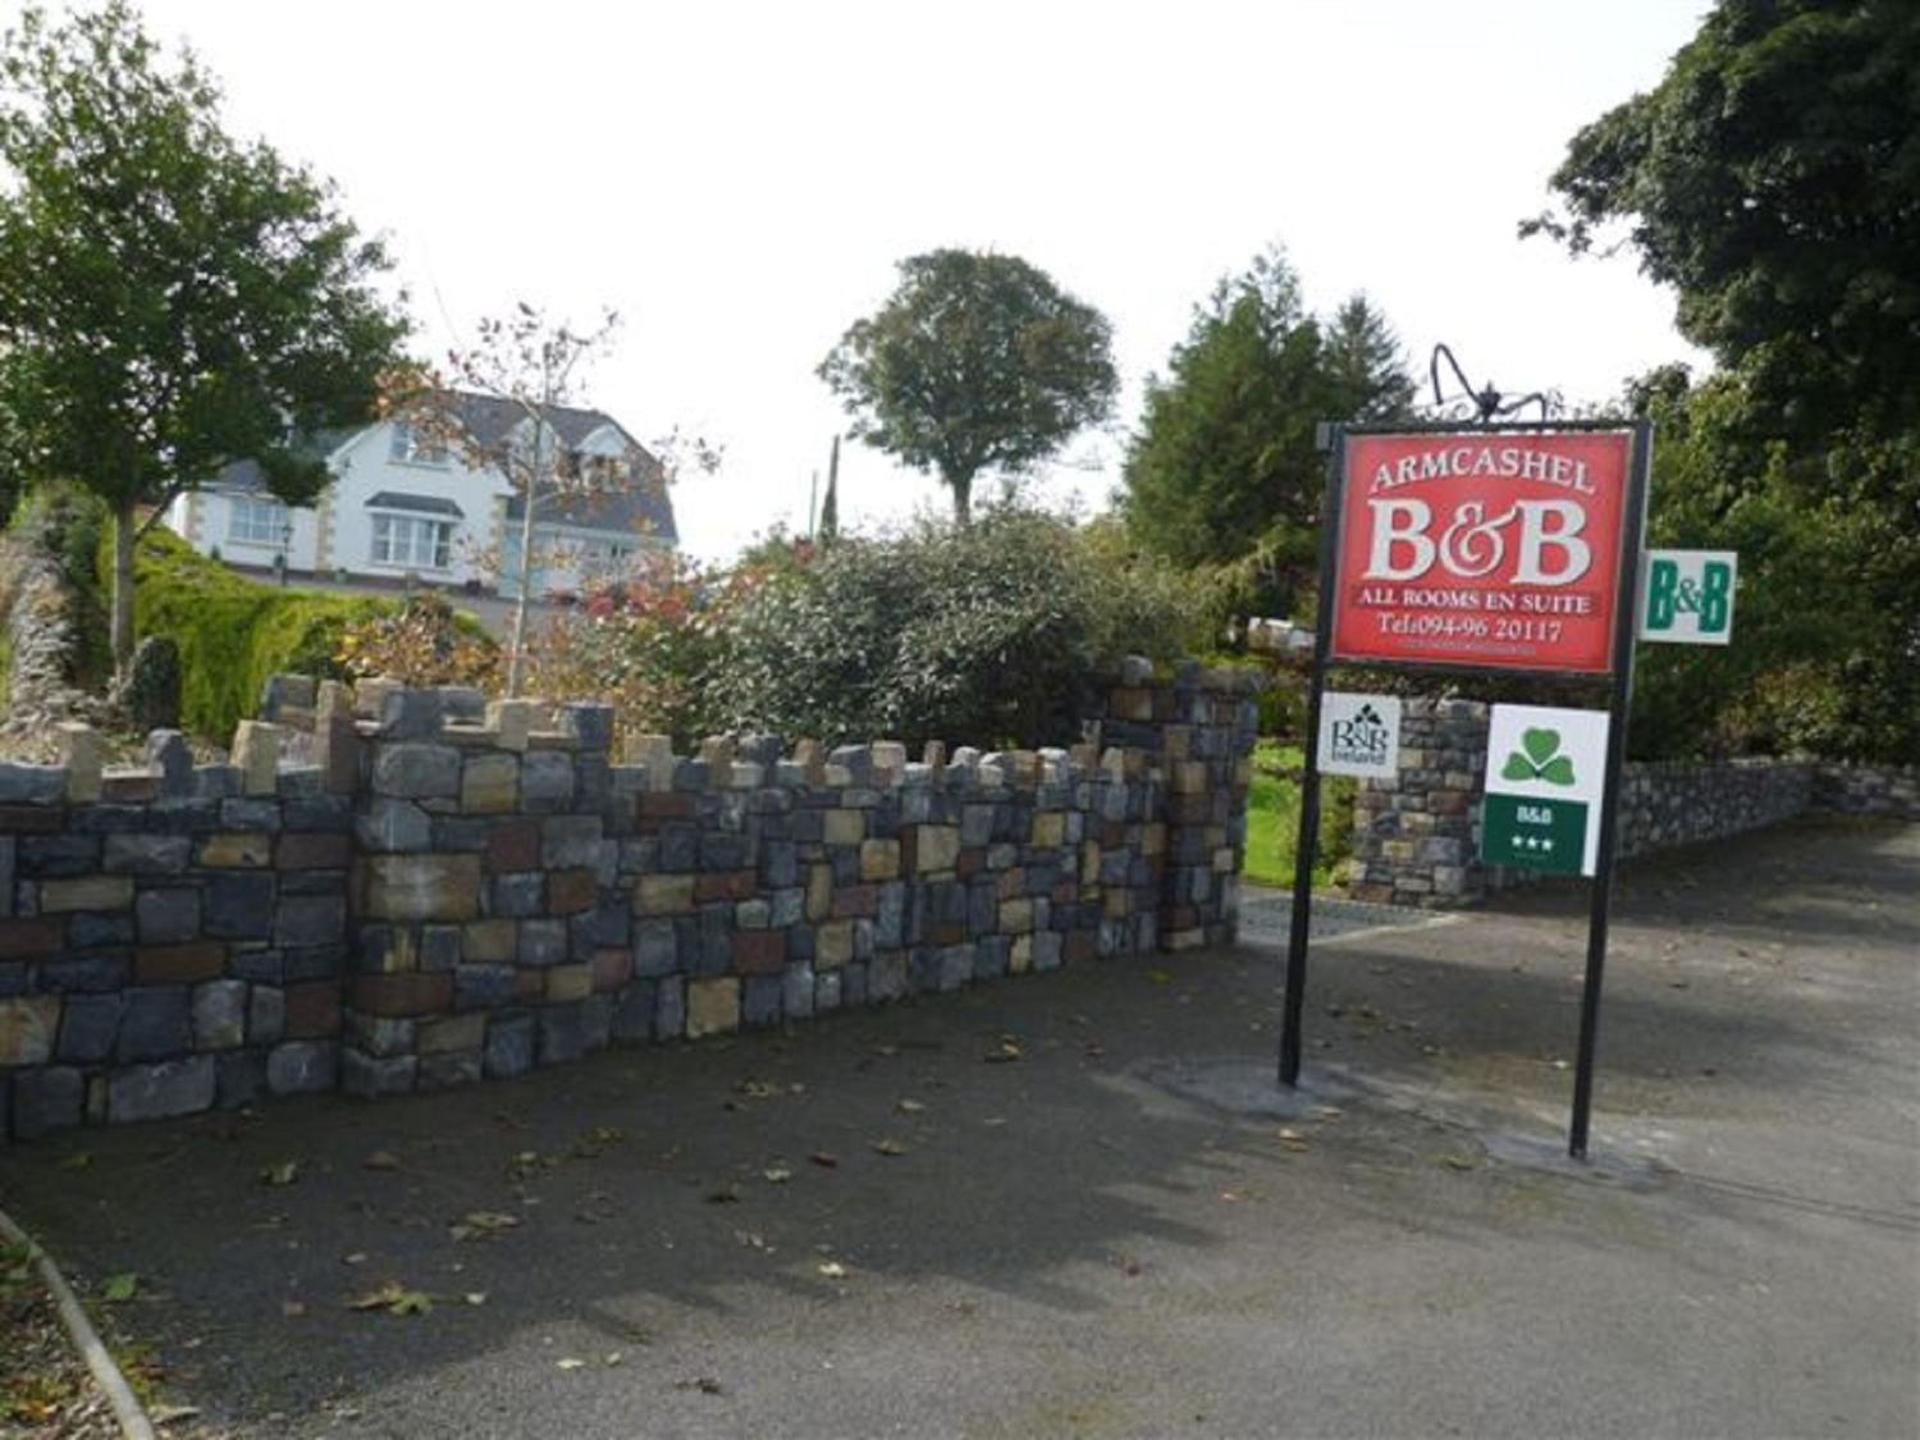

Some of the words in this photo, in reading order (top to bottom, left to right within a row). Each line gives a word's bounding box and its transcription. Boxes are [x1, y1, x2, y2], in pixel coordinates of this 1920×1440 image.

[1369, 448, 1595, 495] ARMCASHEL
[1362, 498, 1592, 587] B&B
[1360, 588, 1397, 605] ALL
[1403, 589, 1480, 609] ROOMS
[1485, 593, 1516, 611] EN
[1520, 594, 1590, 614] SUITE
[1646, 559, 1731, 633] B&B
[1496, 618, 1562, 642] 20117
[1331, 719, 1390, 752] B&B
[1331, 748, 1387, 767] Ireland
[1516, 805, 1552, 825] B&B
